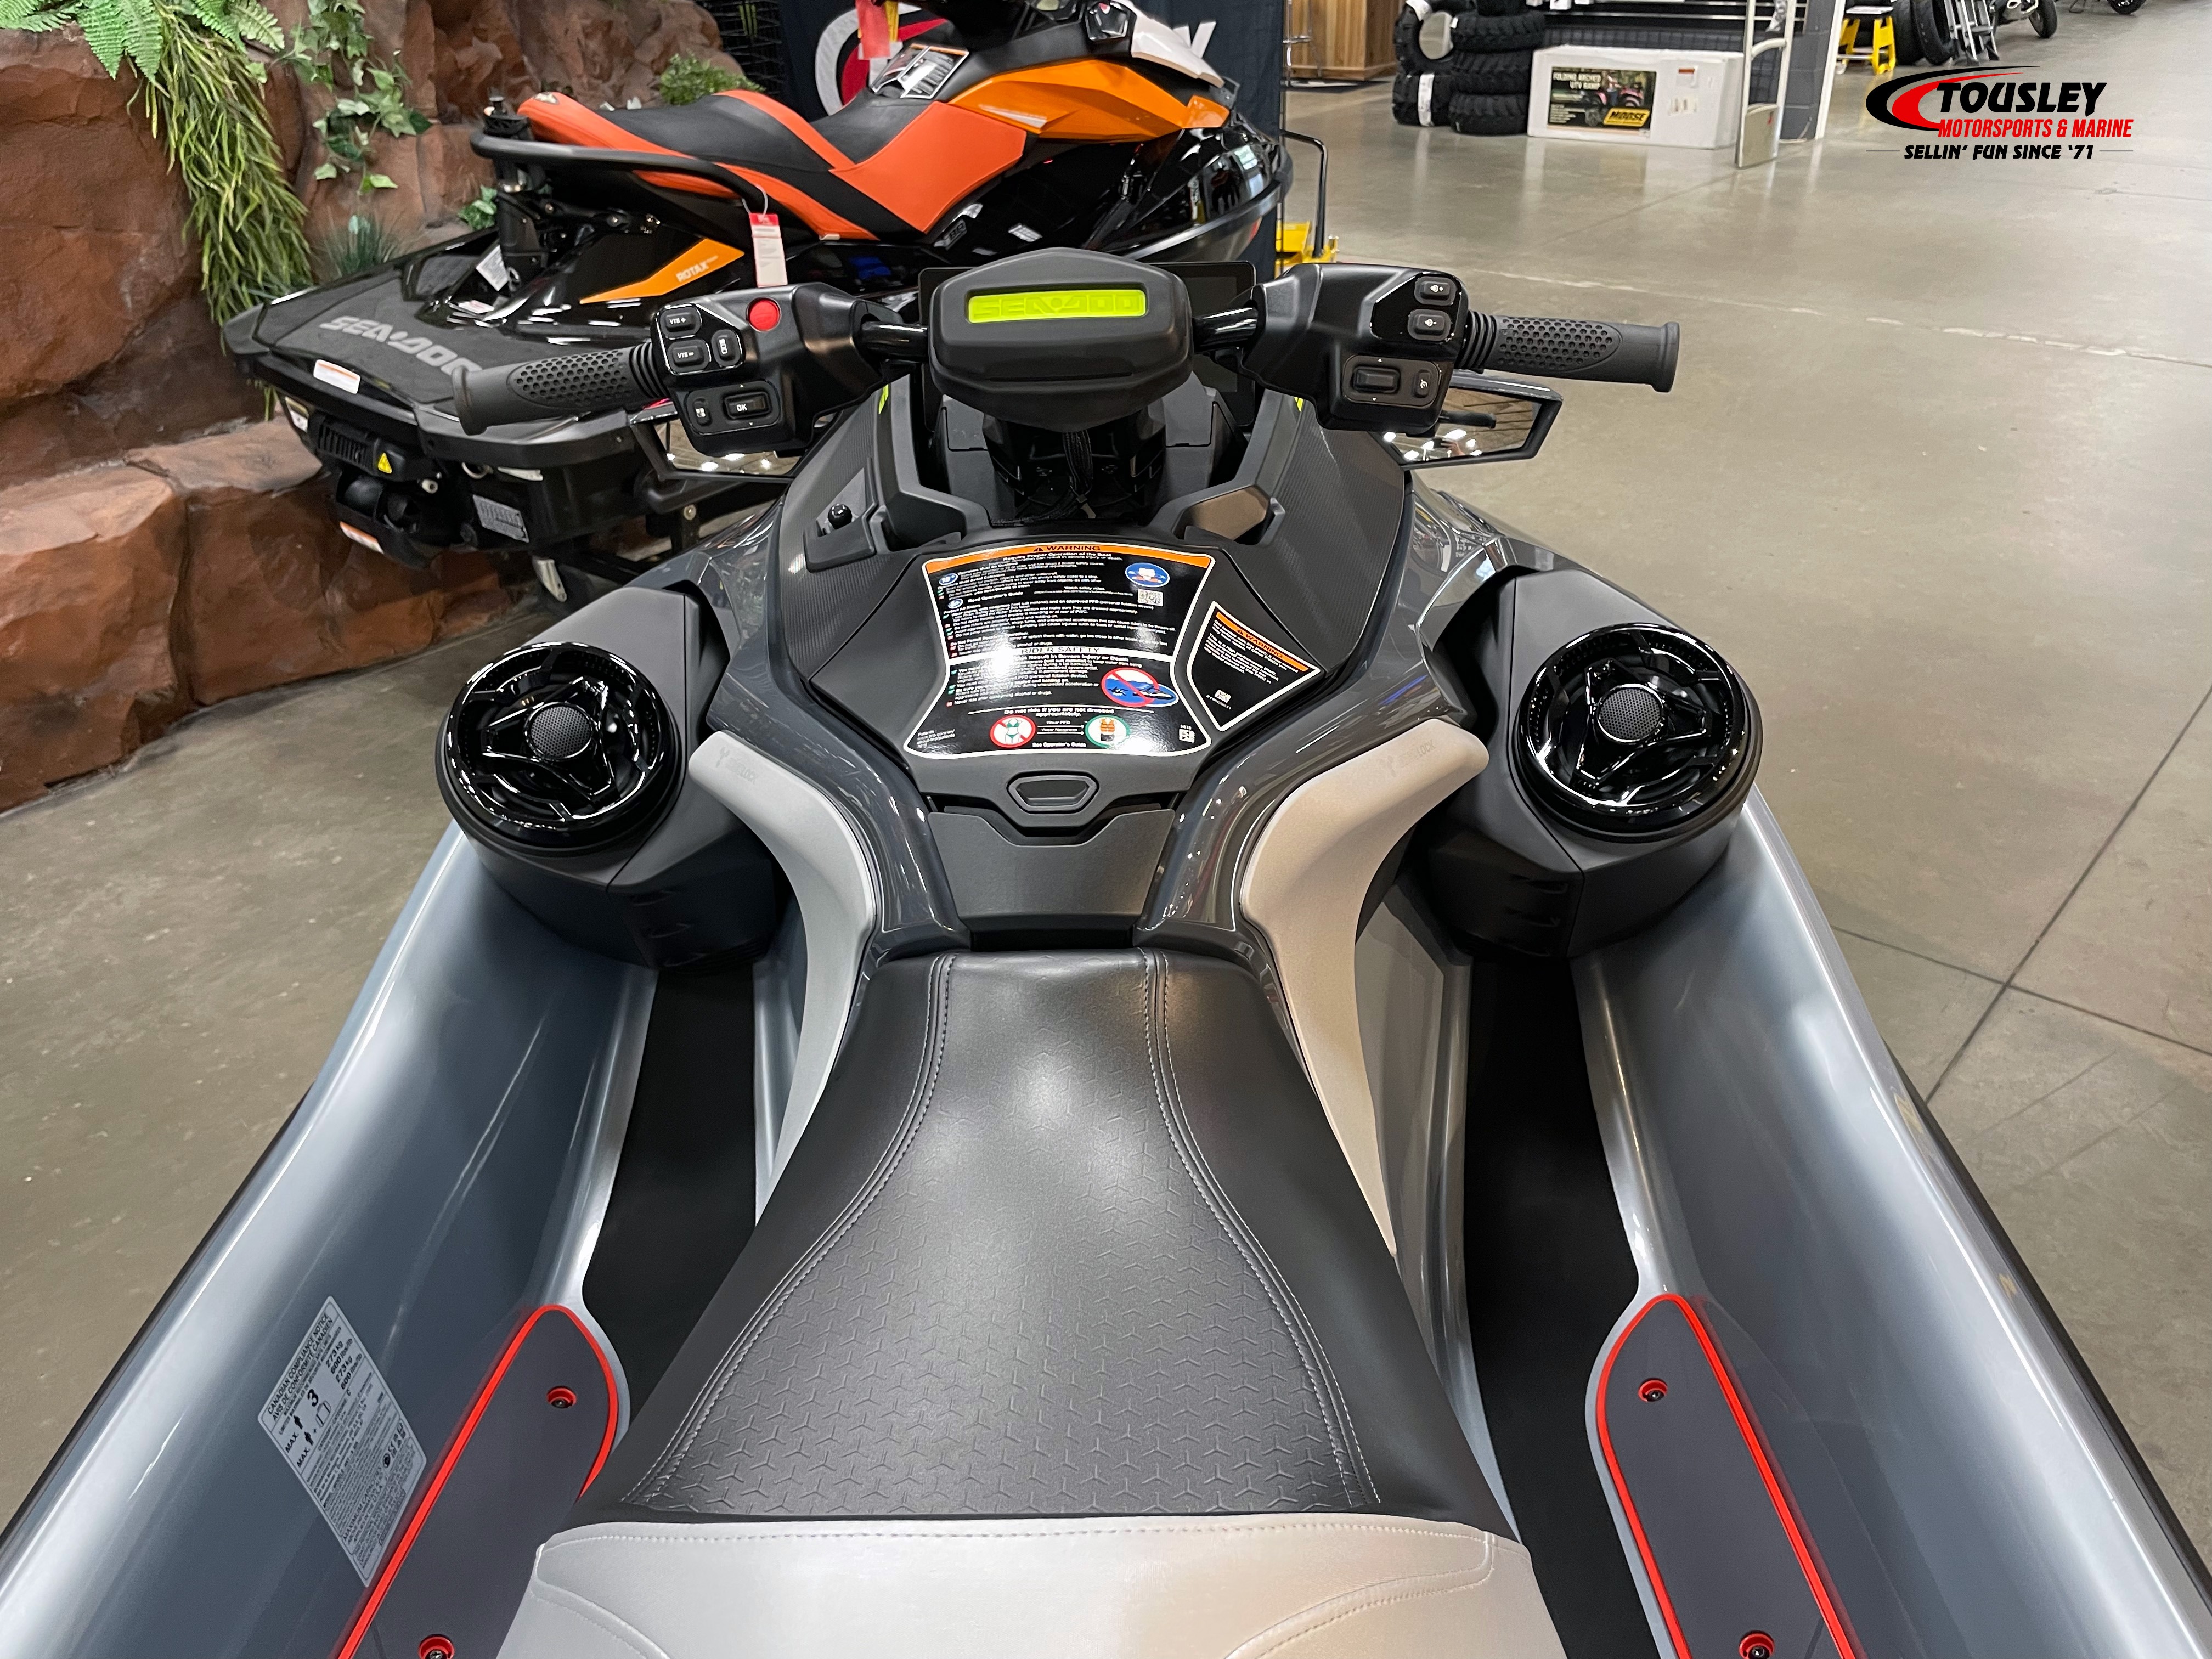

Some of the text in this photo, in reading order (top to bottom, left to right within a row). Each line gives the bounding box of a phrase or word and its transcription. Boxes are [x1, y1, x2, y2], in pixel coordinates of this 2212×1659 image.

[1610, 111, 1646, 121] MOOSE
[676, 262, 709, 282] ROTAX
[736, 403, 748, 412] OK
[1246, 634, 1282, 658] WARNING
[268, 1313, 329, 1414] CANADIAN COMPLIANCE NOTICE
[273, 1404, 283, 1421] AVIS
[282, 1393, 289, 1404] DE
[313, 1318, 332, 1351] CANADIEN
[308, 1341, 343, 1407] 3 273 kg
[336, 1356, 352, 1383] 273 kg
[285, 1432, 297, 1453] MAX.
[331, 1356, 341, 1374] 600
[297, 1448, 309, 1467] MAX.
[341, 1372, 351, 1390] 600
